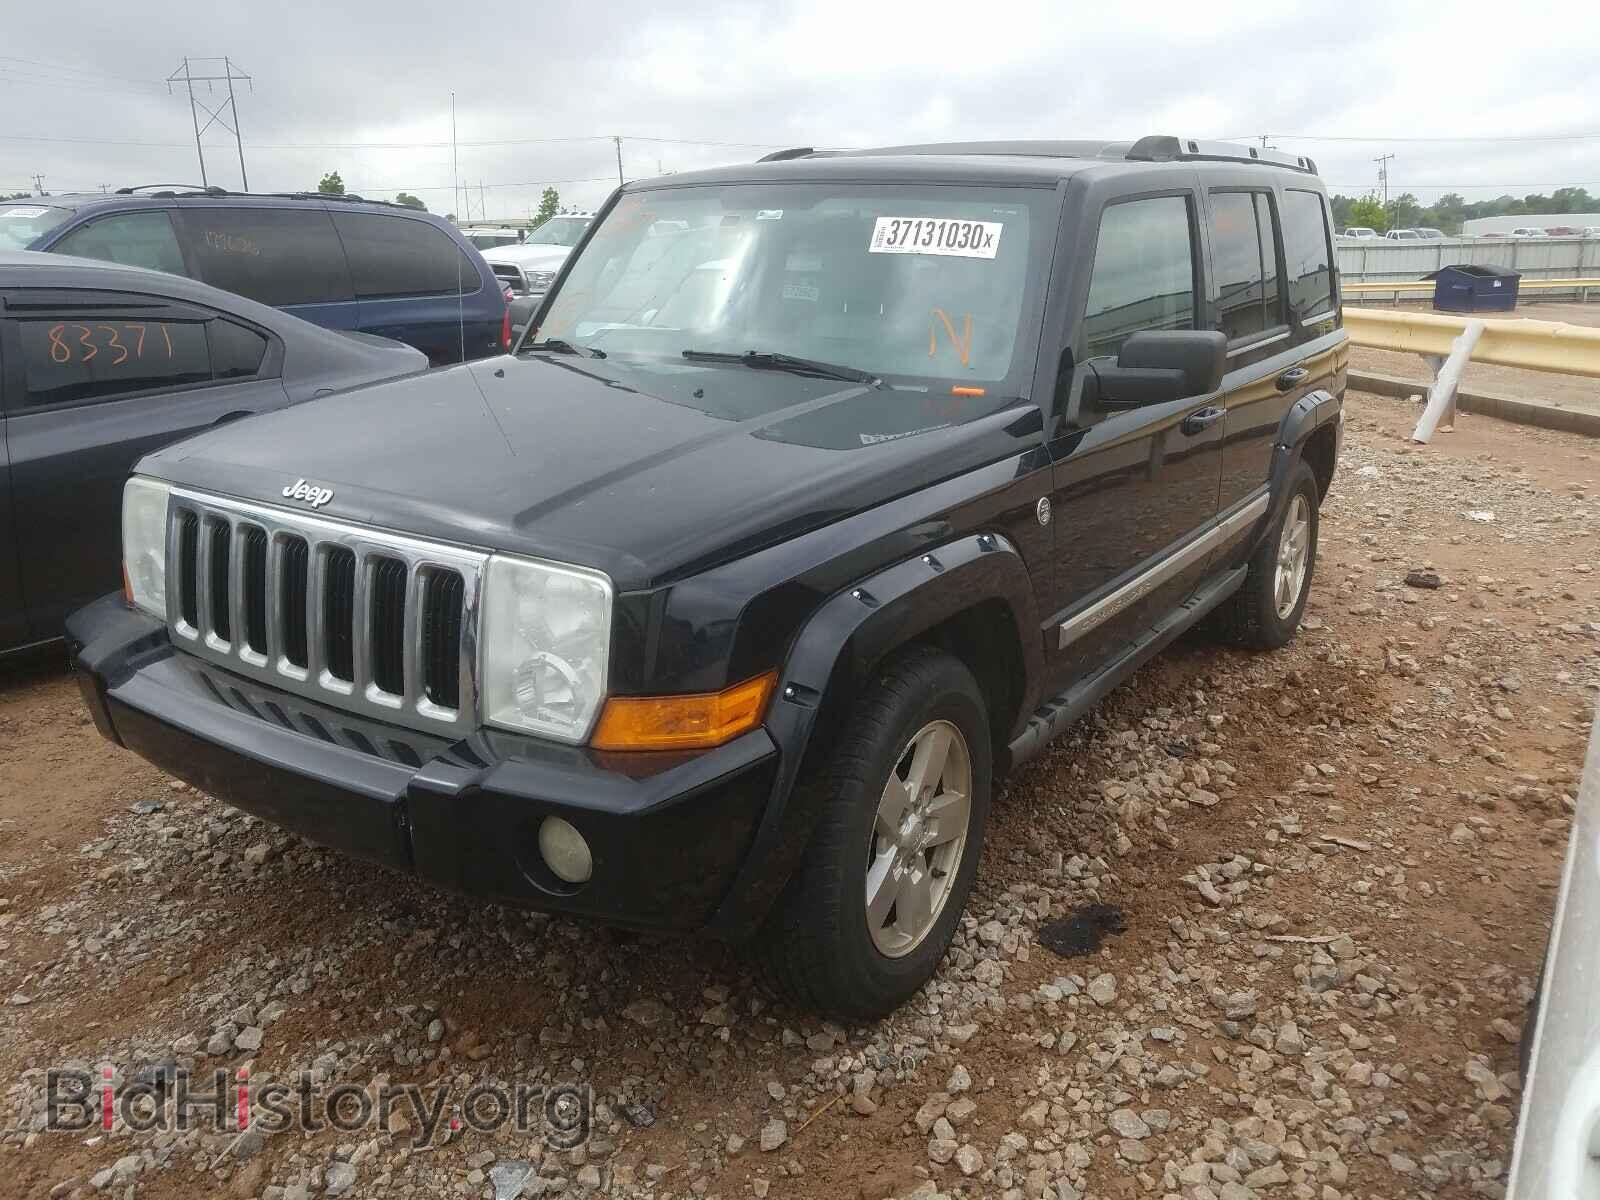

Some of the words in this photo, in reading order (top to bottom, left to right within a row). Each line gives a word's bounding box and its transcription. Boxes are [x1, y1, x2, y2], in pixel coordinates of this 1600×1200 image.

[48, 323, 171, 364] 83371
[928, 307, 972, 368] N
[282, 479, 334, 509] Jeep
